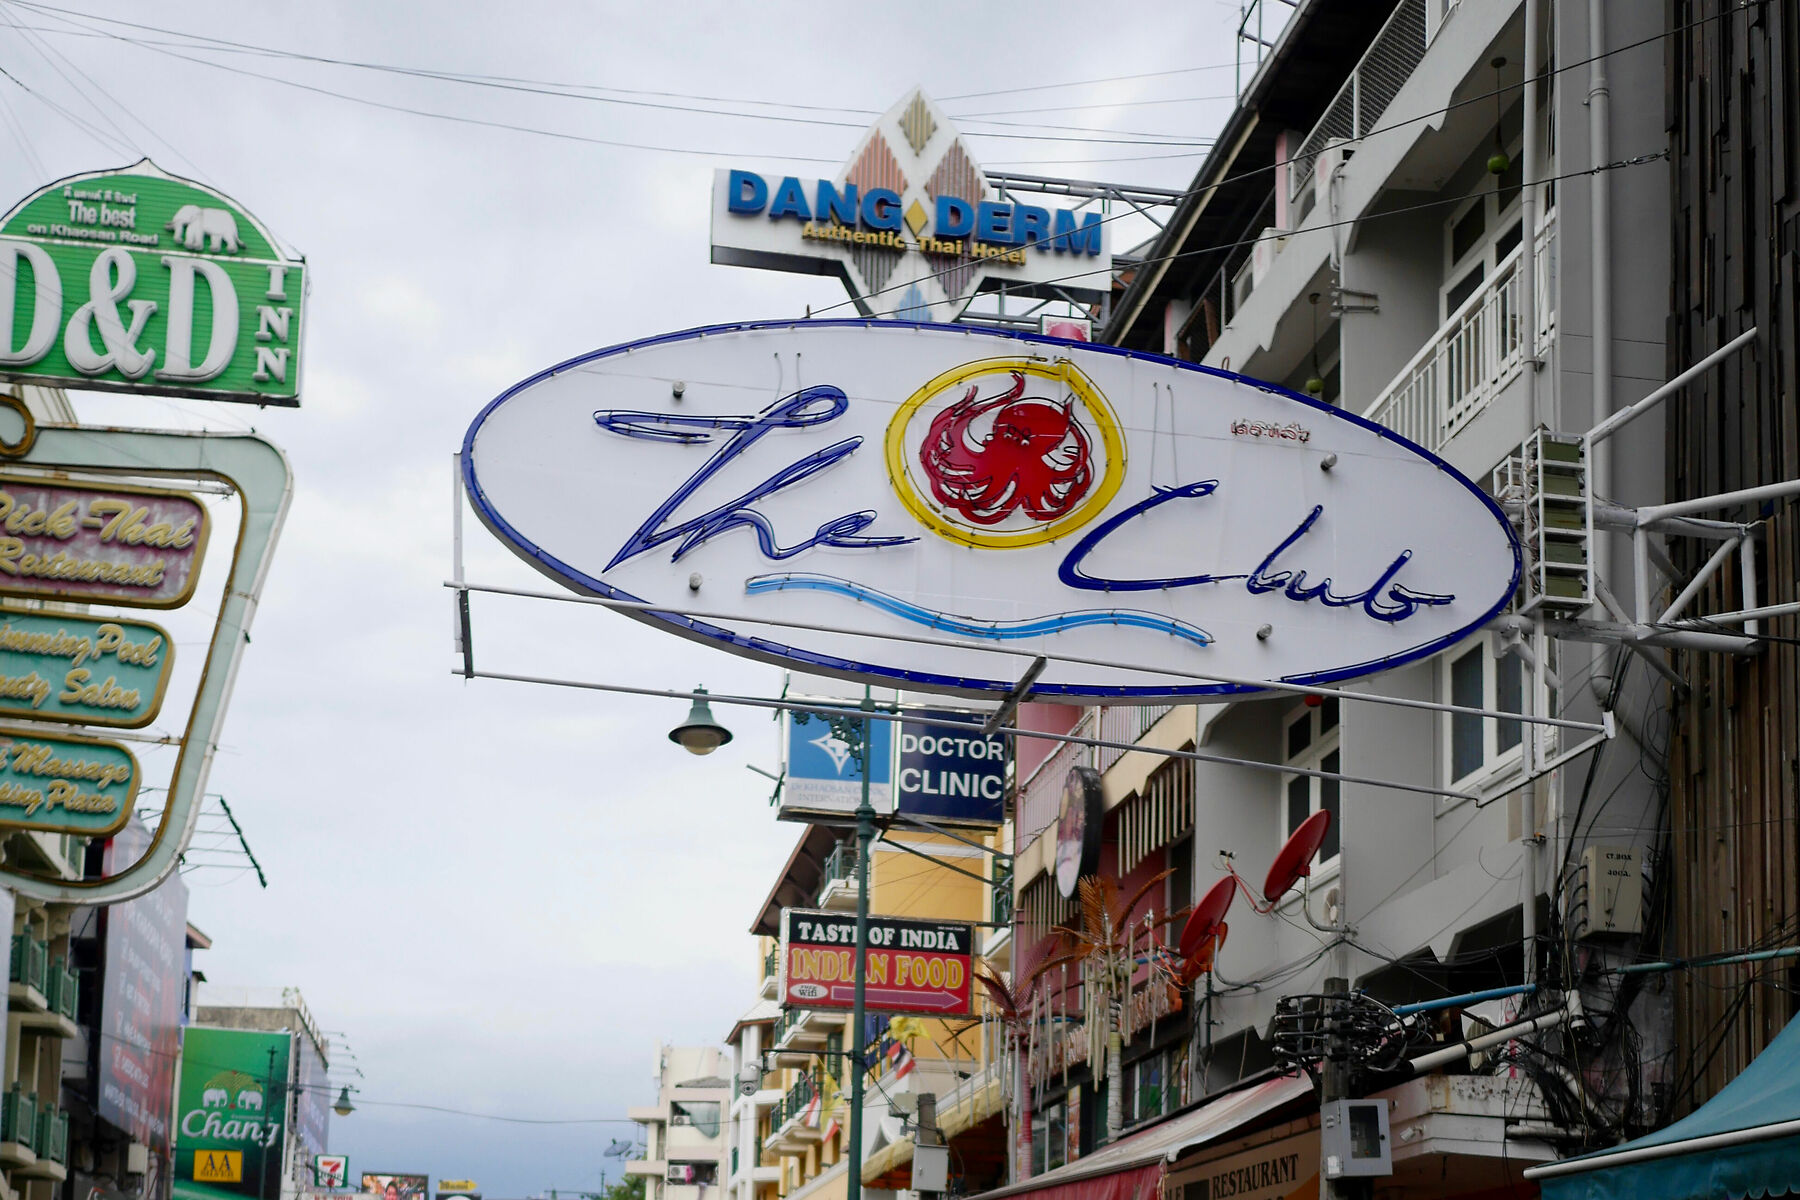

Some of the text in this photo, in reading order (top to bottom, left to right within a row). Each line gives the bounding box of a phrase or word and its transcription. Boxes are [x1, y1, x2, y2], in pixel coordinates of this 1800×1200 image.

[27, 224, 159, 246] on Khaosan Road
[68, 200, 136, 229] The best
[728, 169, 1101, 257] DANG DERM
[801, 221, 1027, 266] Authentic Thai Hotel
[0, 240, 240, 384] D&D
[253, 265, 293, 384] INN
[592, 384, 922, 575] The
[1058, 479, 1455, 623] Club
[91, 623, 162, 668] Pool
[58, 667, 141, 712] Salon
[11, 742, 130, 791] Massage
[901, 733, 1004, 762] DOCTOR
[46, 779, 117, 813] Plaza
[899, 767, 1003, 800] CLINIC
[868, 926, 895, 946] OF
[900, 929, 960, 951] INDIA
[895, 955, 964, 989] FOOD
[181, 1109, 280, 1148] Chang
[1212, 1152, 1299, 1200] RESTAURANT
